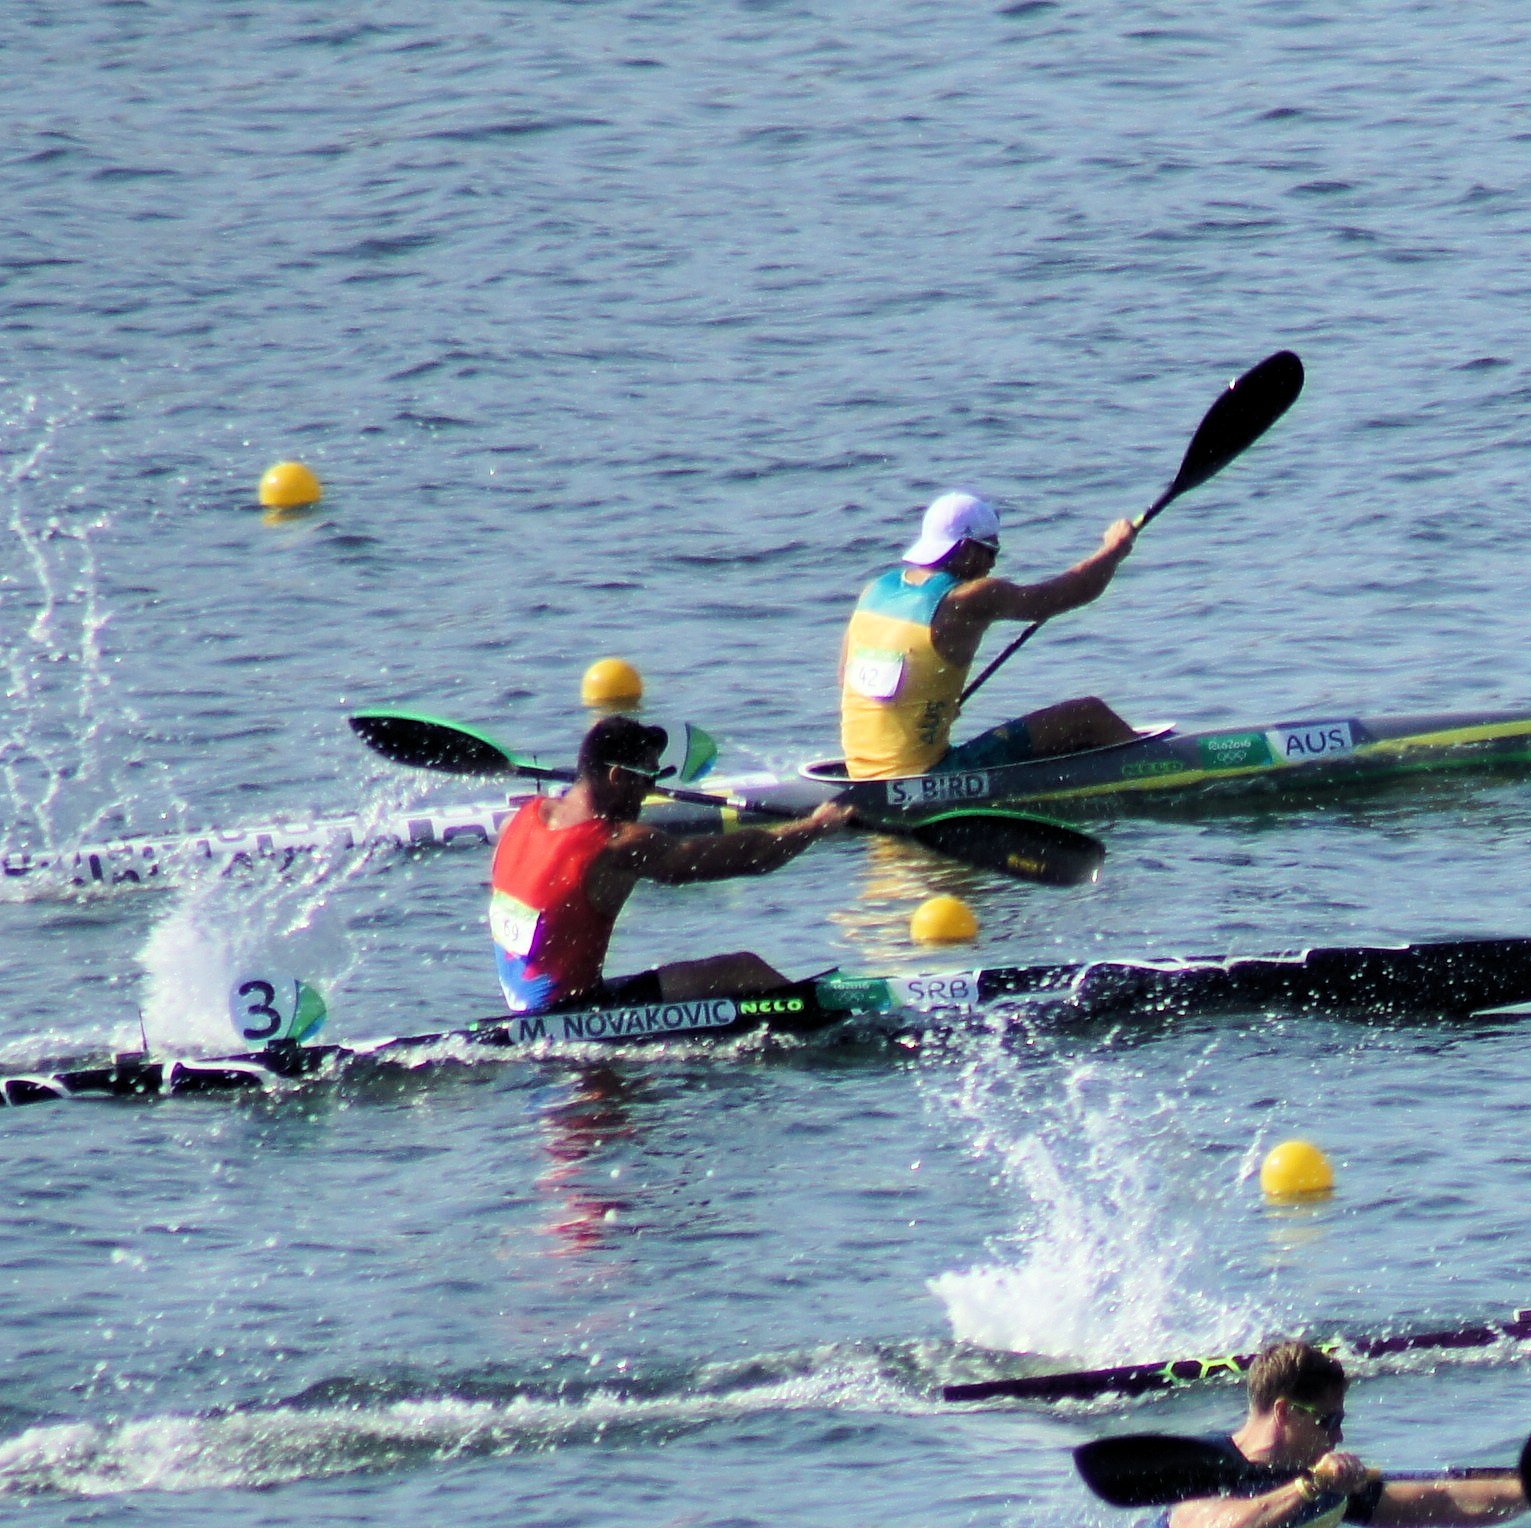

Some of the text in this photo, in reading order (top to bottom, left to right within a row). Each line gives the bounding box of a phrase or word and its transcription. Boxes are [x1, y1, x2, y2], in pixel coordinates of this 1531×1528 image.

[1286, 728, 1345, 756] AUS
[922, 775, 986, 799] BIRD
[908, 980, 969, 1000] SRB
[239, 980, 282, 1039] 3
[563, 1000, 731, 1039] NOVAKOVIC
